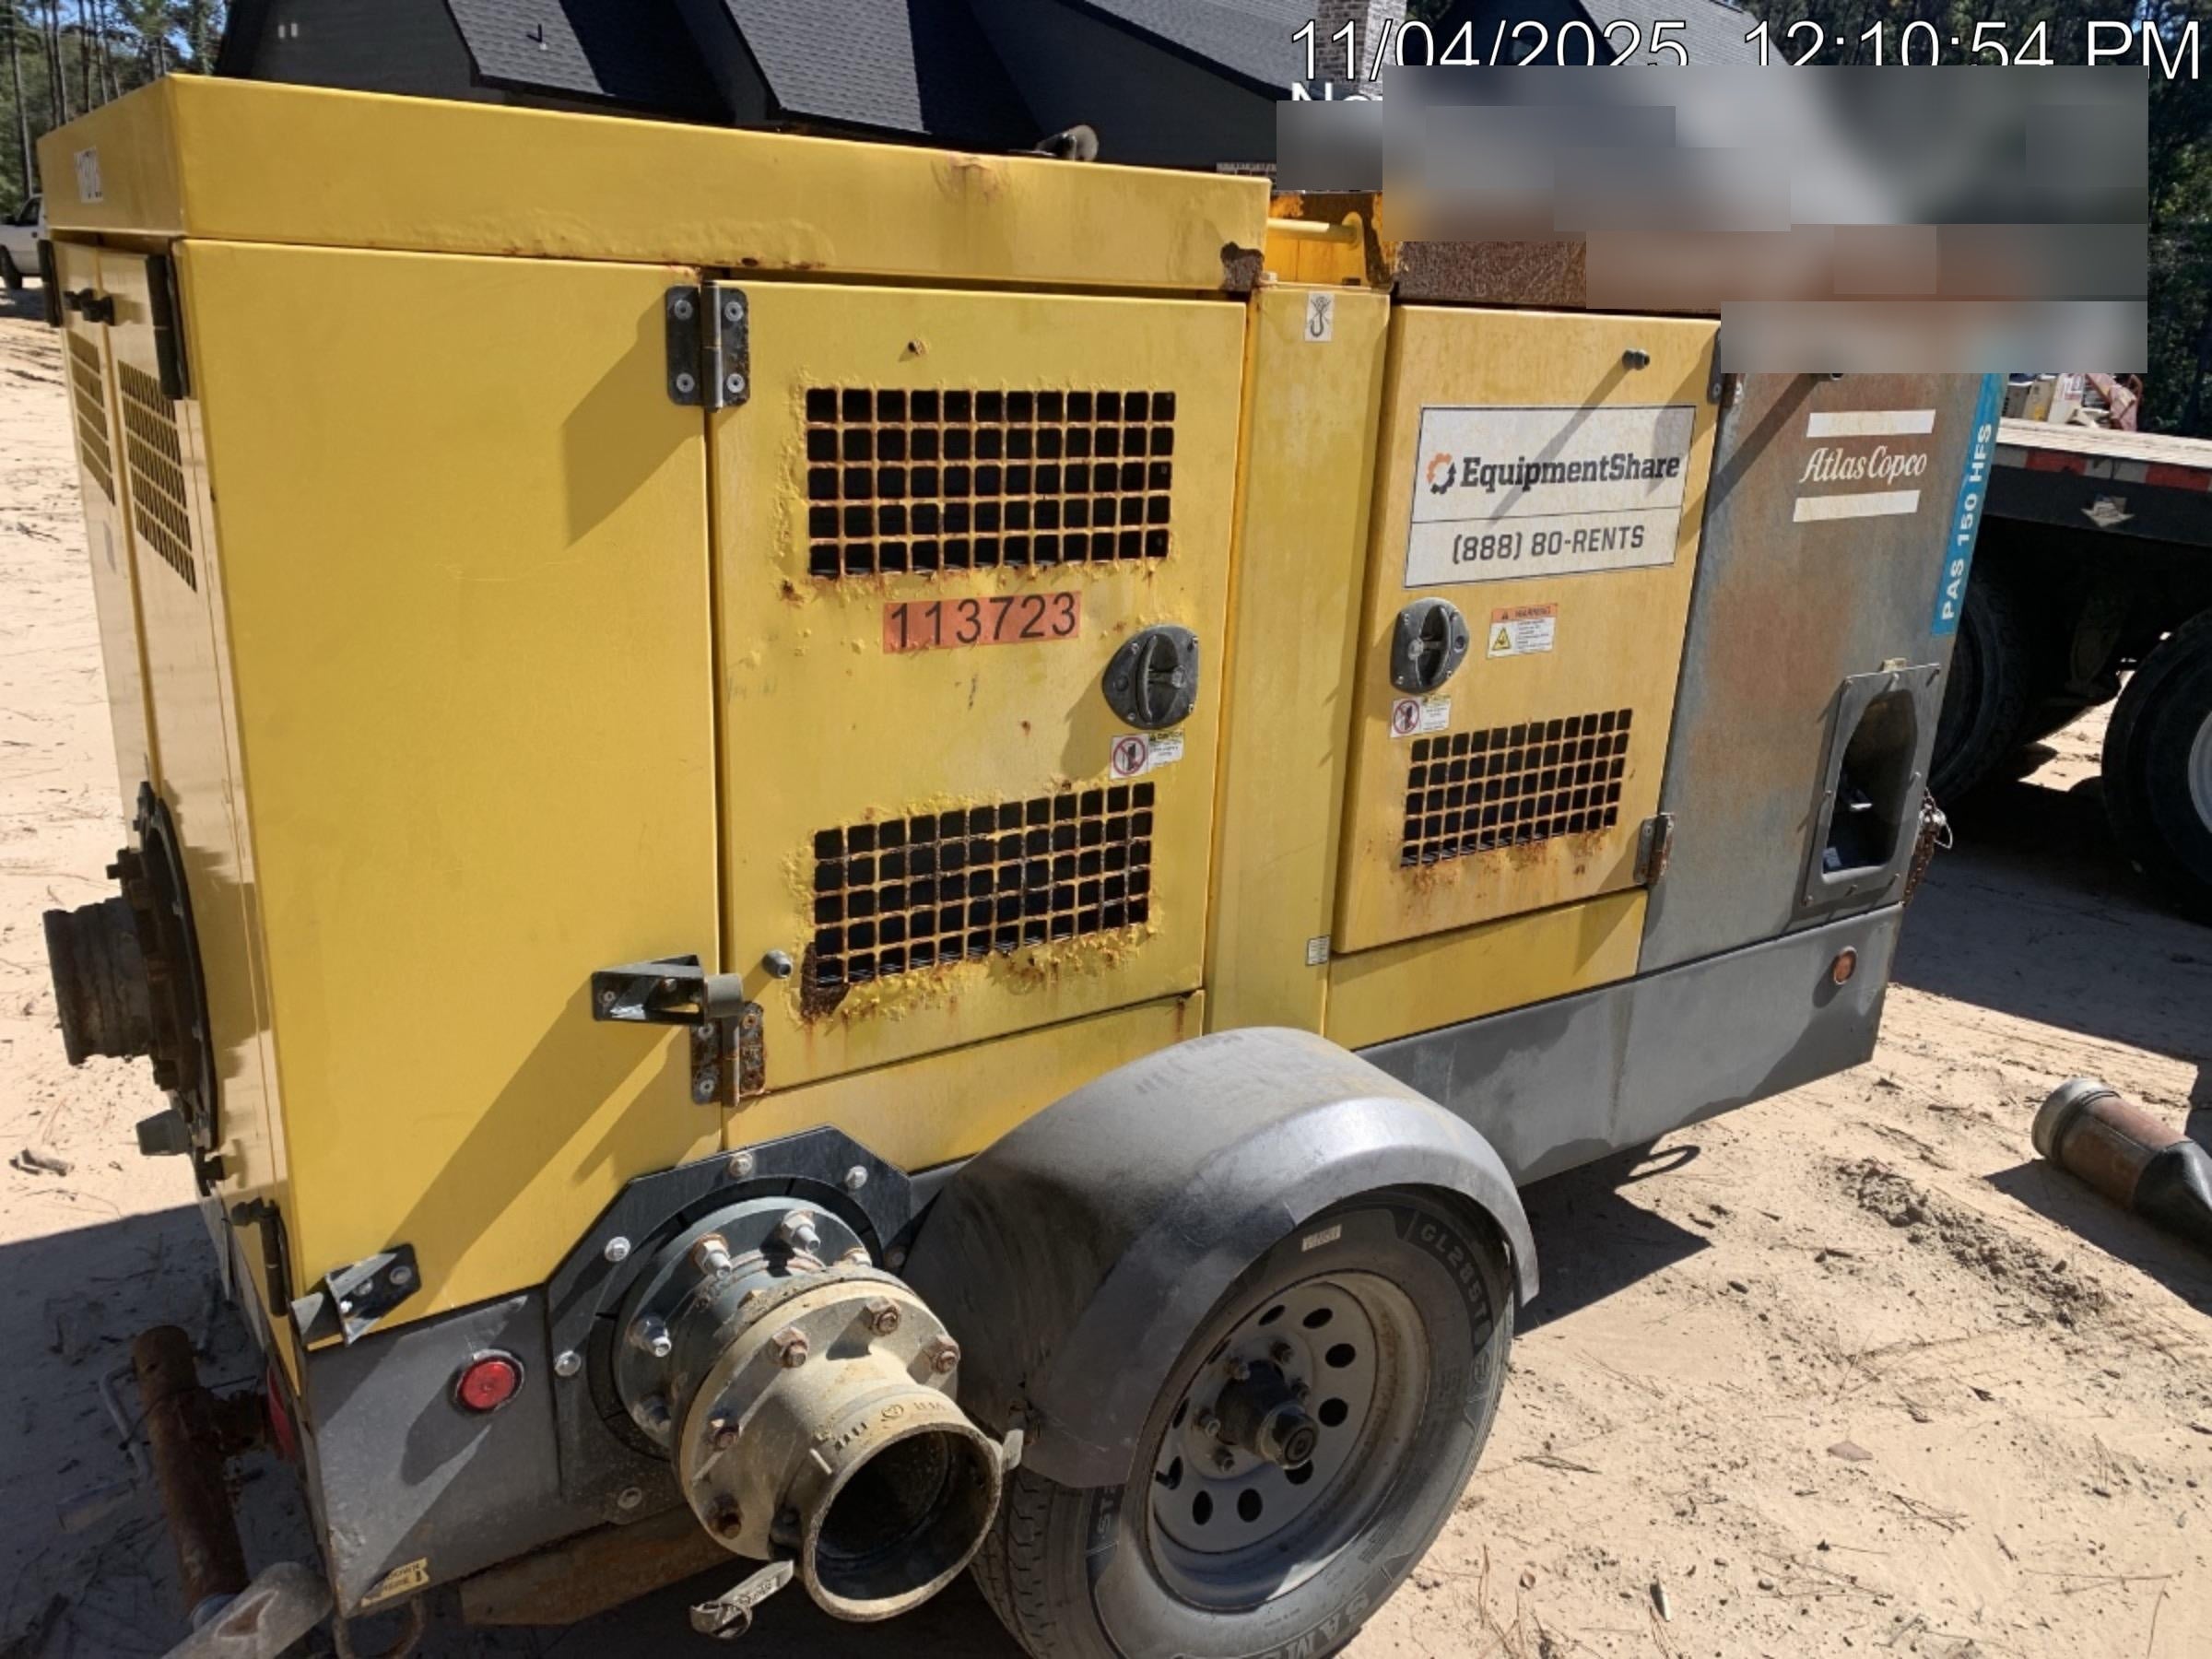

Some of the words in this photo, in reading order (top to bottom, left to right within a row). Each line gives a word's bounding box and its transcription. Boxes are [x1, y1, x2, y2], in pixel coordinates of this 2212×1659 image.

[1460, 453, 1680, 493] EquipmentShare
[1799, 447, 1868, 484] Atlas
[1868, 445, 1927, 485] Copco
[1942, 558, 1964, 620] PAS
[1957, 493, 1978, 546] 150
[1969, 423, 1992, 482] HFS
[1453, 532, 1522, 564] (888)
[1531, 525, 1645, 557] 80-RENTS
[891, 592, 1076, 648] 113723
